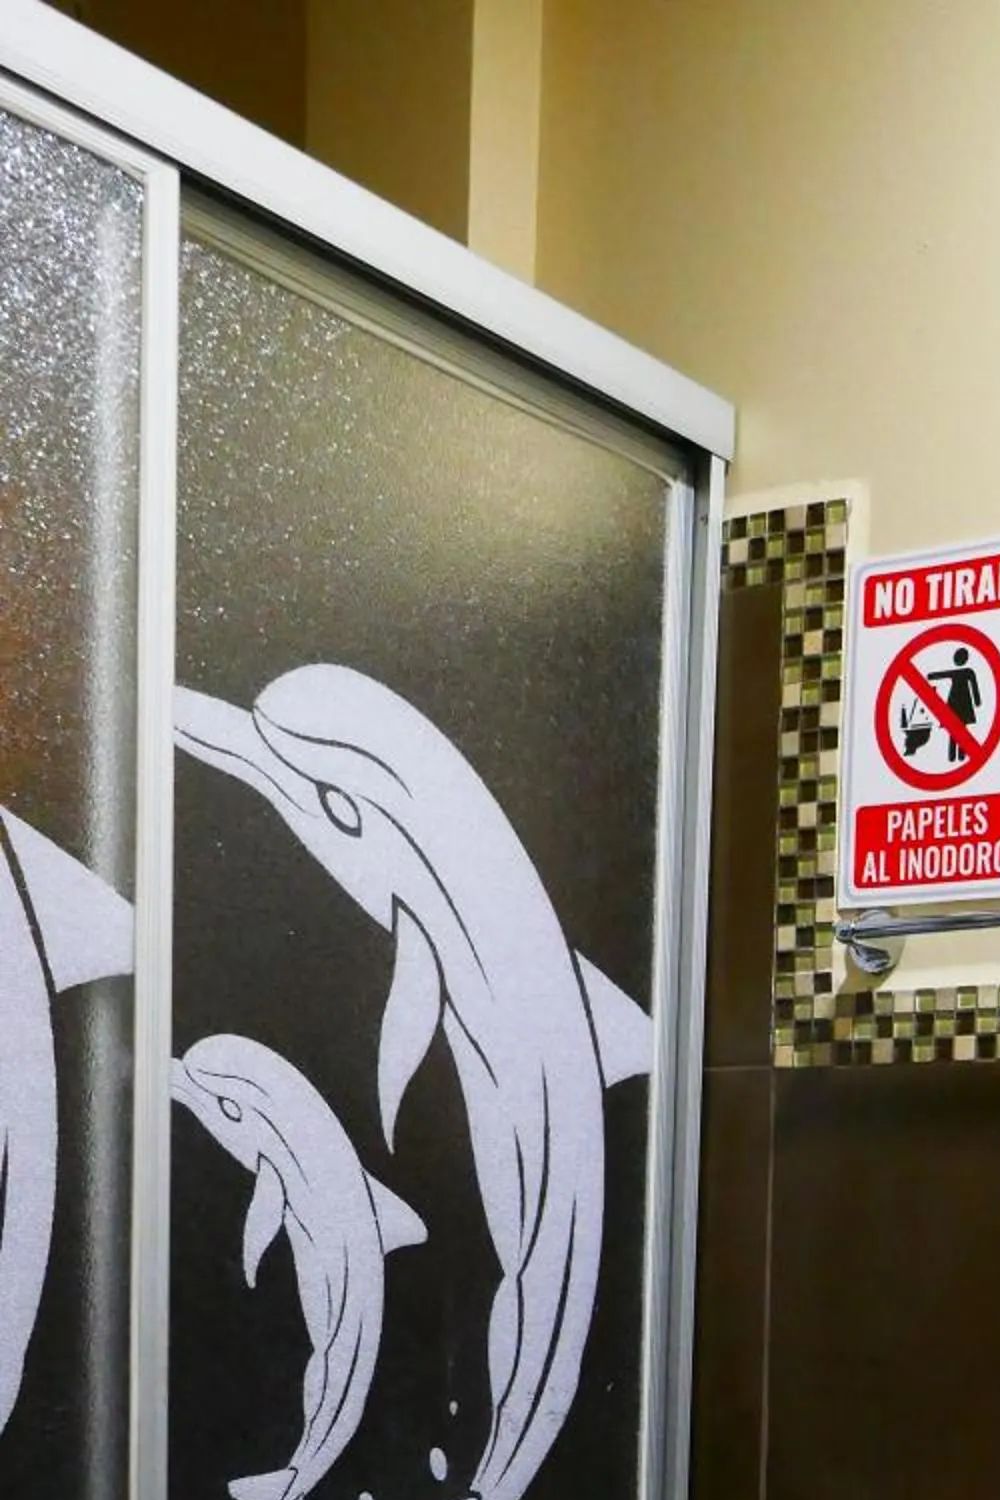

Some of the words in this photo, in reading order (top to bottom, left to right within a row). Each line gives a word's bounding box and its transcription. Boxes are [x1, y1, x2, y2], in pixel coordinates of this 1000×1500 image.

[873, 576, 915, 620] NO
[886, 801, 989, 844] PAPELES
[861, 850, 892, 884] AL
